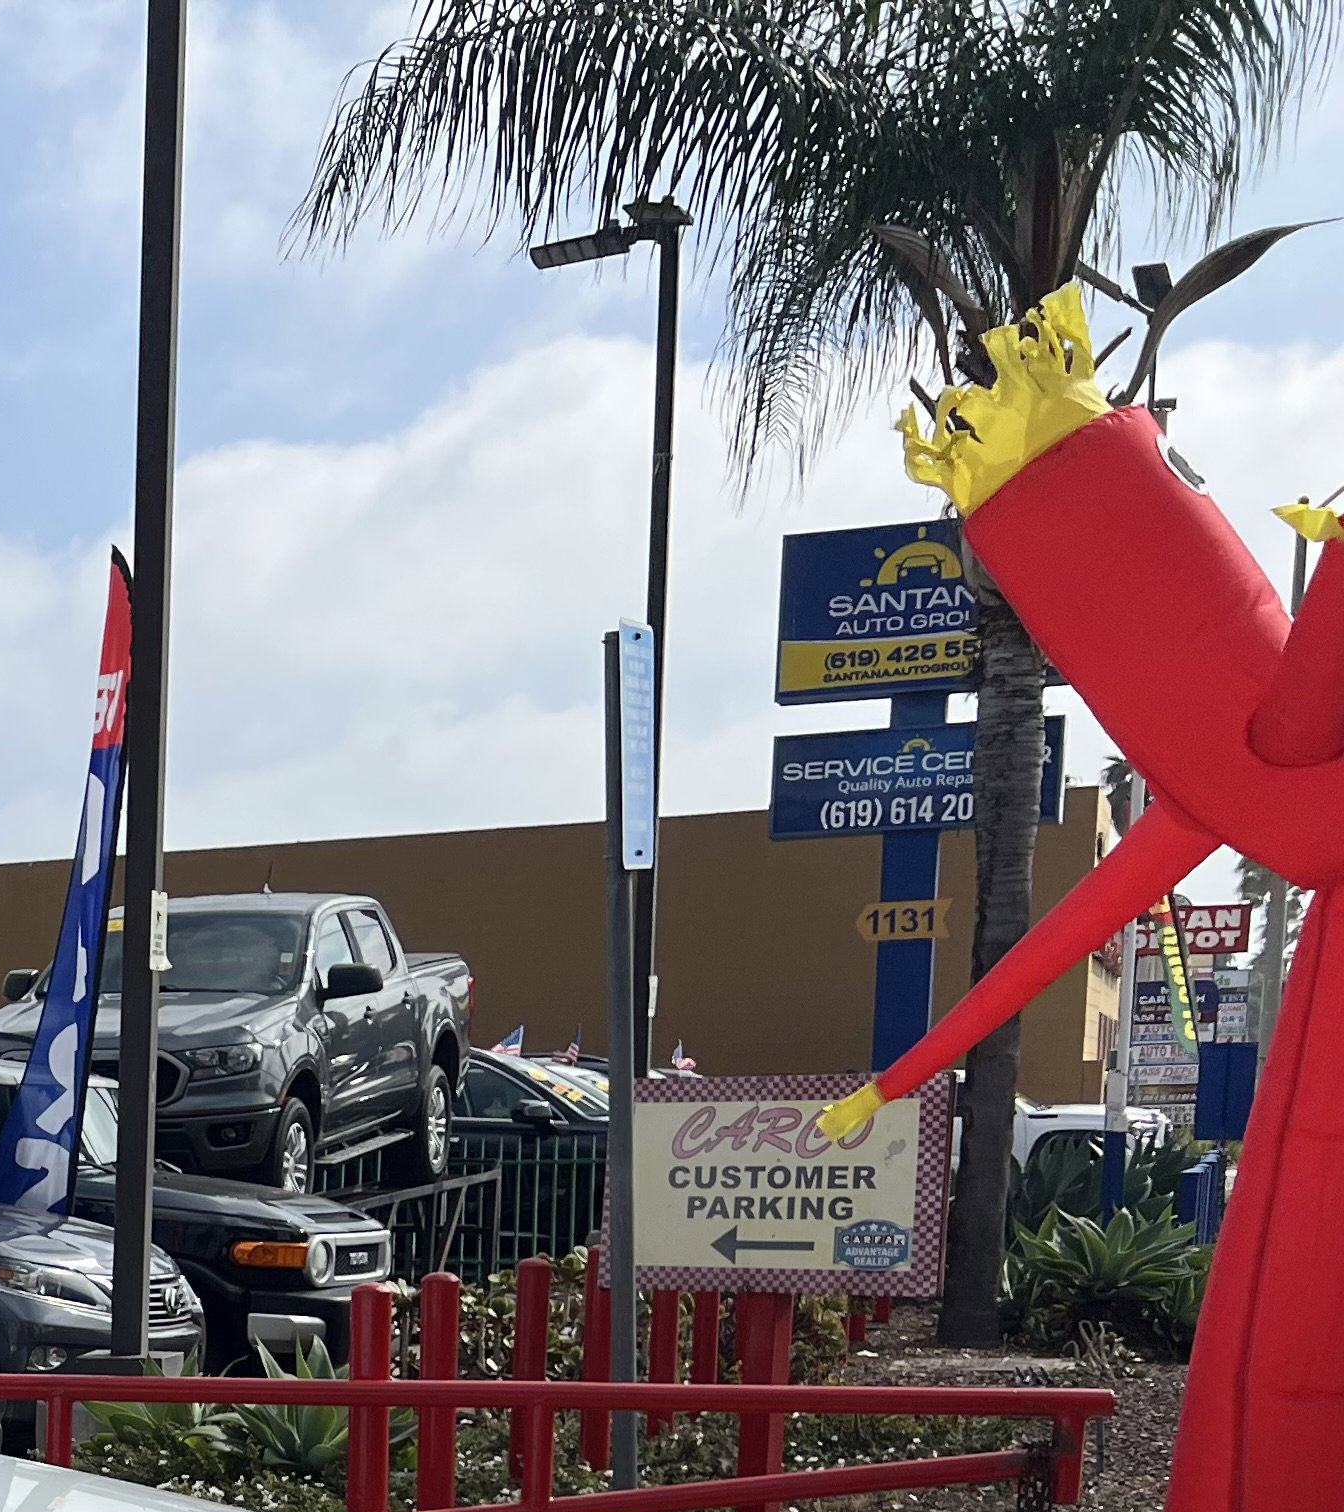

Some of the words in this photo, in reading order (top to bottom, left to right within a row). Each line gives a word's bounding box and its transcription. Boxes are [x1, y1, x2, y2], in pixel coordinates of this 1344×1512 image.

[828, 584, 978, 617] SANTAN
[835, 615, 904, 636] AUTO
[910, 610, 970, 630] GRO
[824, 648, 880, 672] (619)
[886, 643, 938, 664] 426
[944, 638, 983, 659] 55
[822, 661, 973, 684] SANTANAAUTOGROU
[782, 754, 915, 783] SERVICE
[838, 778, 892, 794] Quality
[895, 775, 932, 789] Auto
[936, 772, 974, 788] Repa
[819, 797, 883, 830] (619)
[890, 793, 935, 825] 614
[941, 792, 974, 821] 20
[865, 906, 936, 936] 1131
[668, 1165, 878, 1190] CUSTOMER
[686, 1196, 854, 1220] PARKING
[842, 1234, 905, 1246] CARFAX
[845, 1246, 900, 1257] ADVANTAGE
[853, 1256, 891, 1267] DEALER
